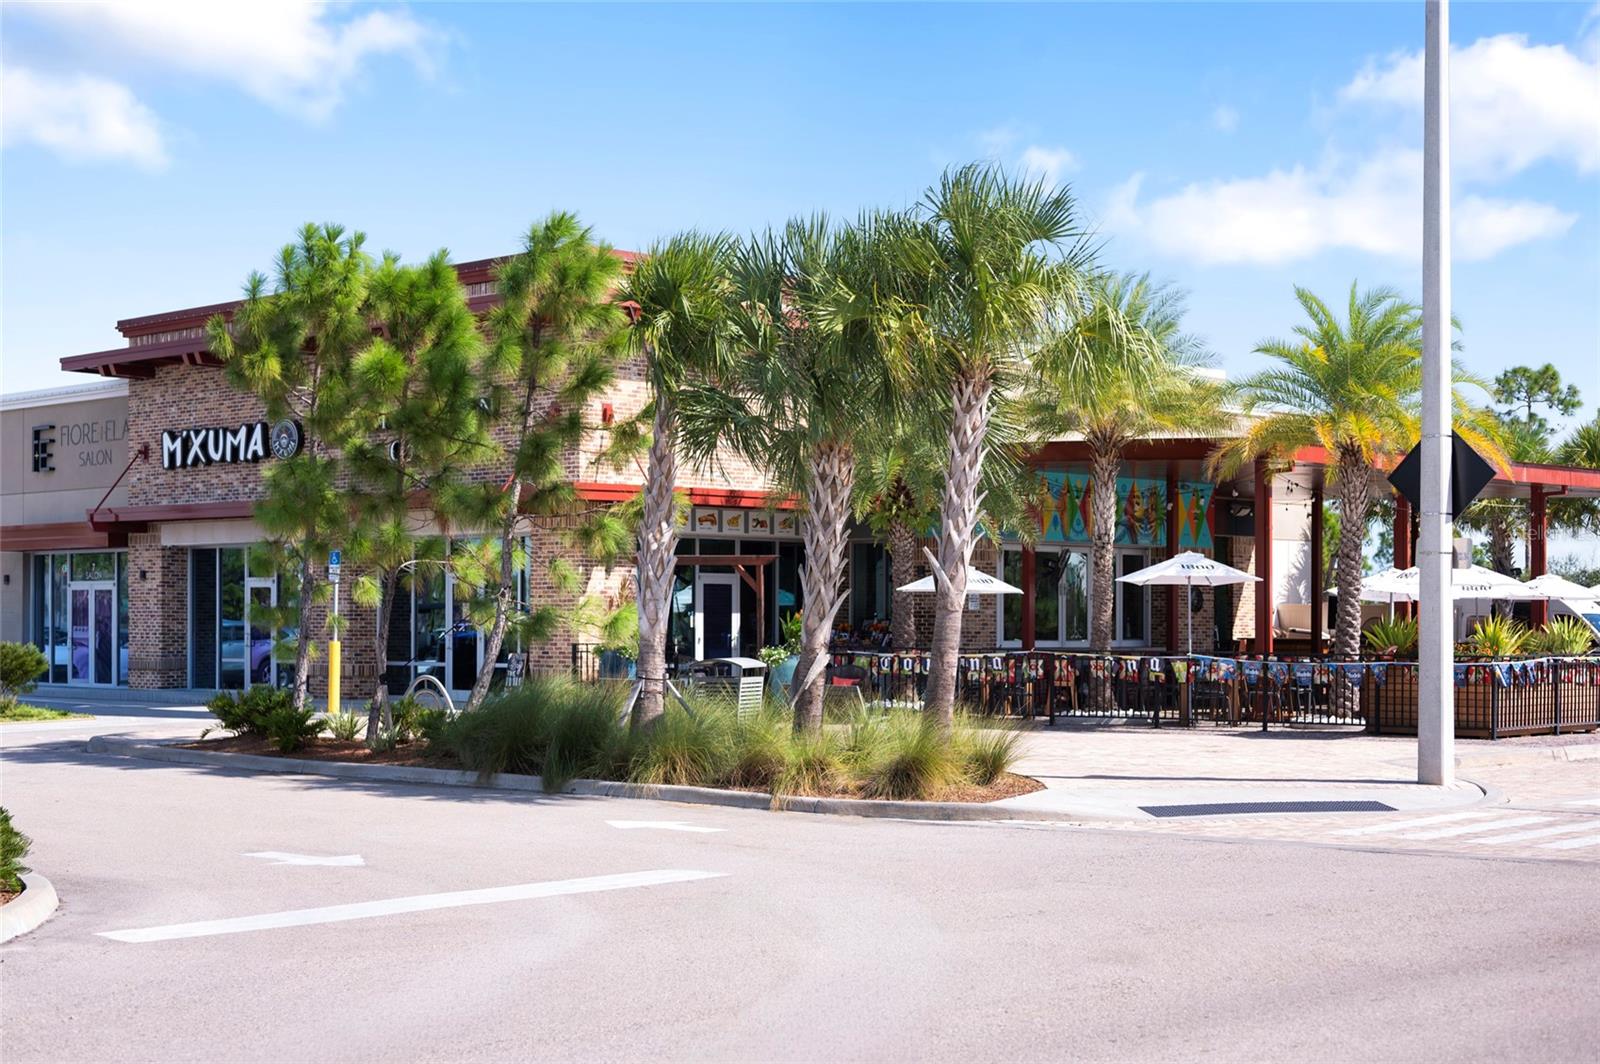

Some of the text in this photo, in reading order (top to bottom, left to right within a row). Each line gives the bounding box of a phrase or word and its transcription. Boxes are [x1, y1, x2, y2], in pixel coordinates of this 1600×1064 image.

[60, 422, 99, 448] FIORE
[162, 423, 264, 469] M'XUMA
[79, 449, 112, 467] SALON
